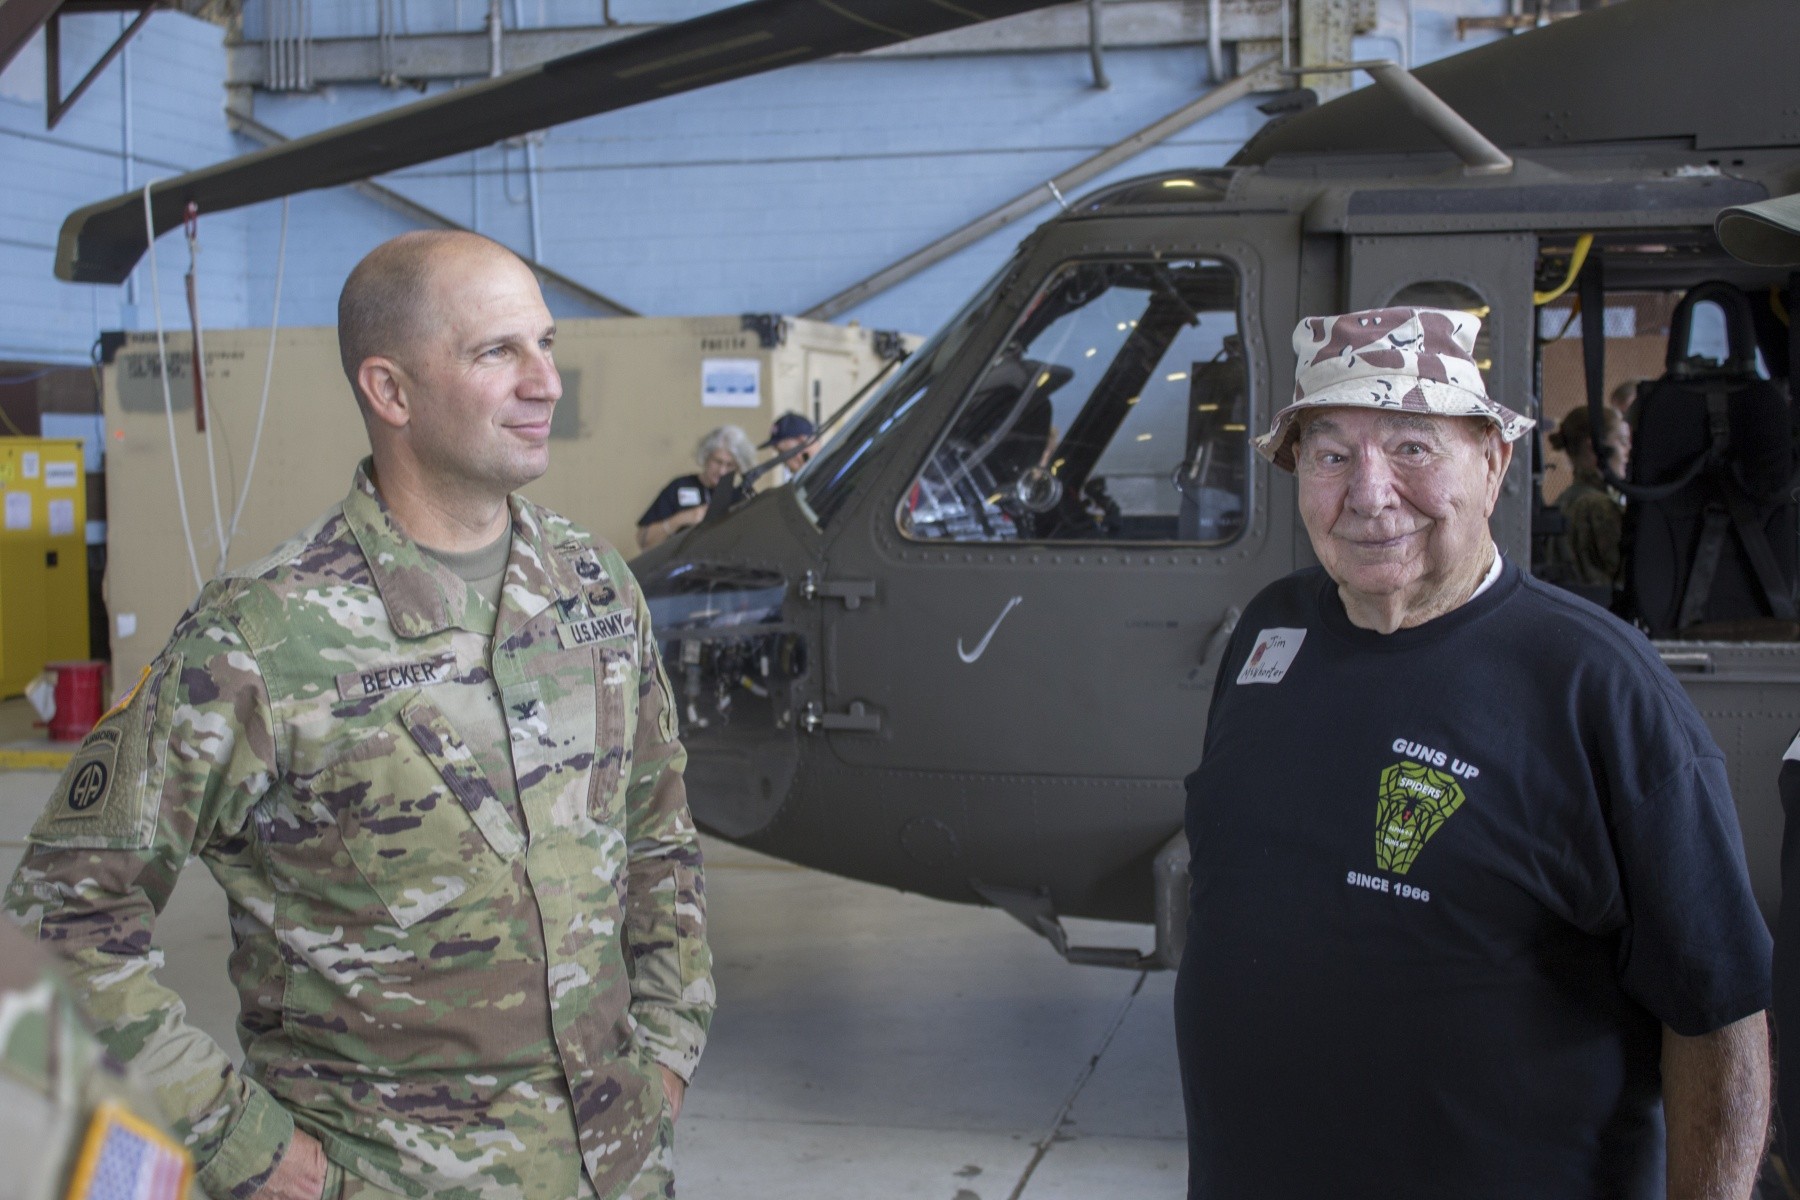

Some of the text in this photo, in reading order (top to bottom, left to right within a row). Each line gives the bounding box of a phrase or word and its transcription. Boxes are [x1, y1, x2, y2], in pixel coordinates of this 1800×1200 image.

[1265, 635, 1286, 650] Jim
[360, 661, 437, 695] BECKER
[1392, 738, 1480, 780] GUNS UP
[1400, 777, 1442, 800] SPIDERS
[1384, 837, 1400, 847] GUNS
[1346, 870, 1431, 903] SINCE 1966
